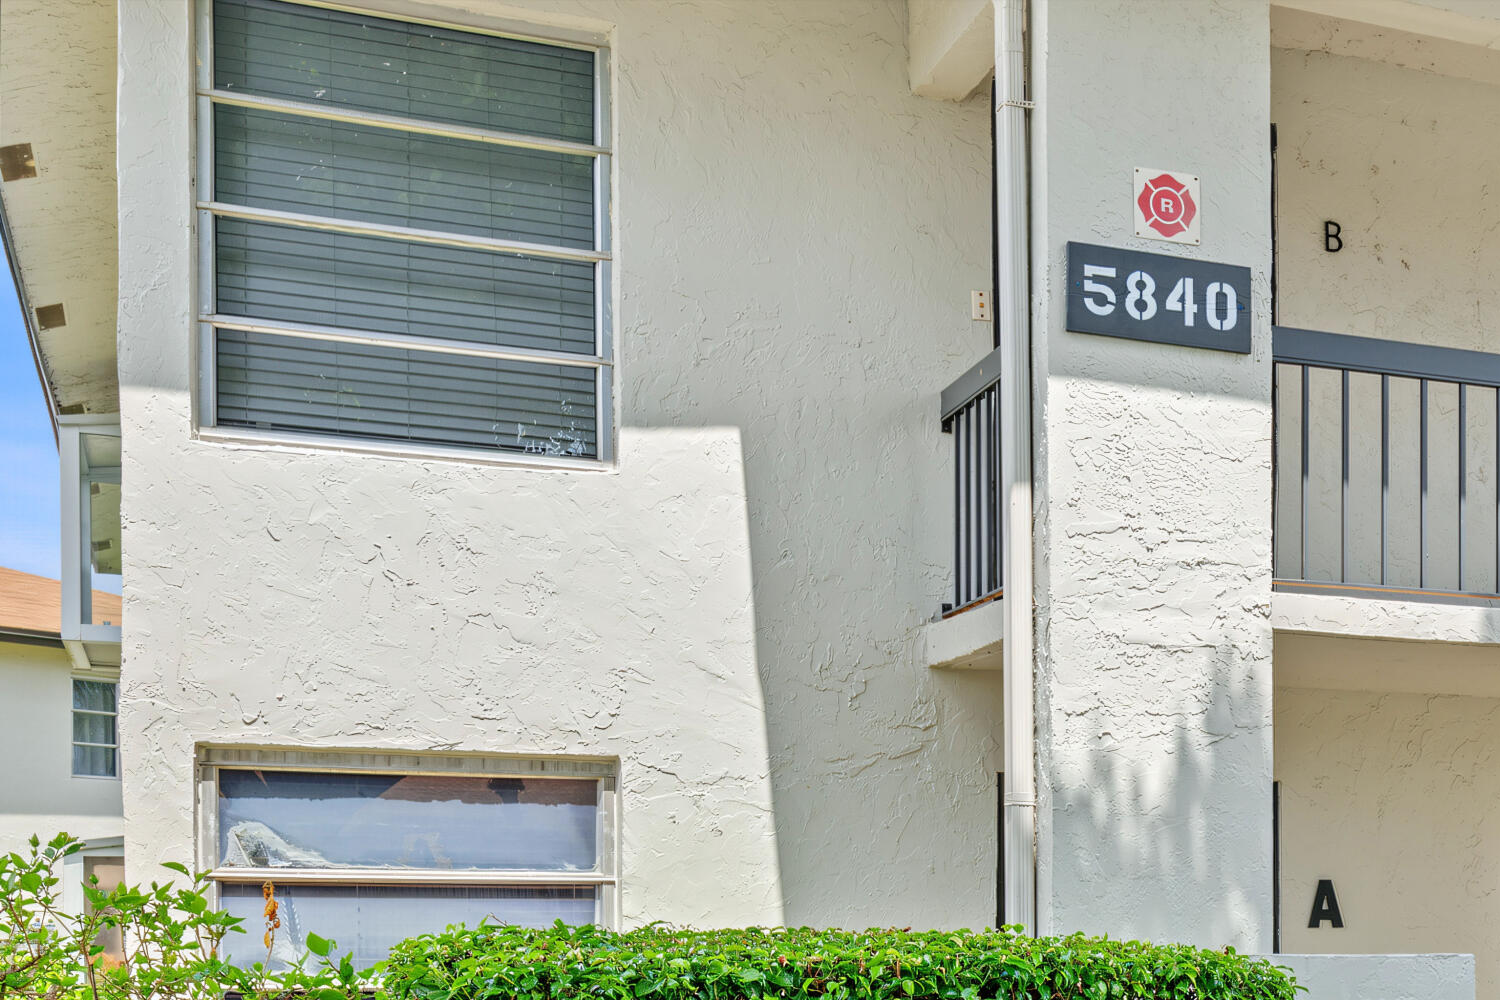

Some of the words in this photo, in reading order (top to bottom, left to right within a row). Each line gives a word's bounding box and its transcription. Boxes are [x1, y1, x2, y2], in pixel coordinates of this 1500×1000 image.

[1160, 198, 1174, 213] R
[1324, 220, 1344, 252] B
[1083, 263, 1237, 331] 5840
[1307, 879, 1345, 928] A
